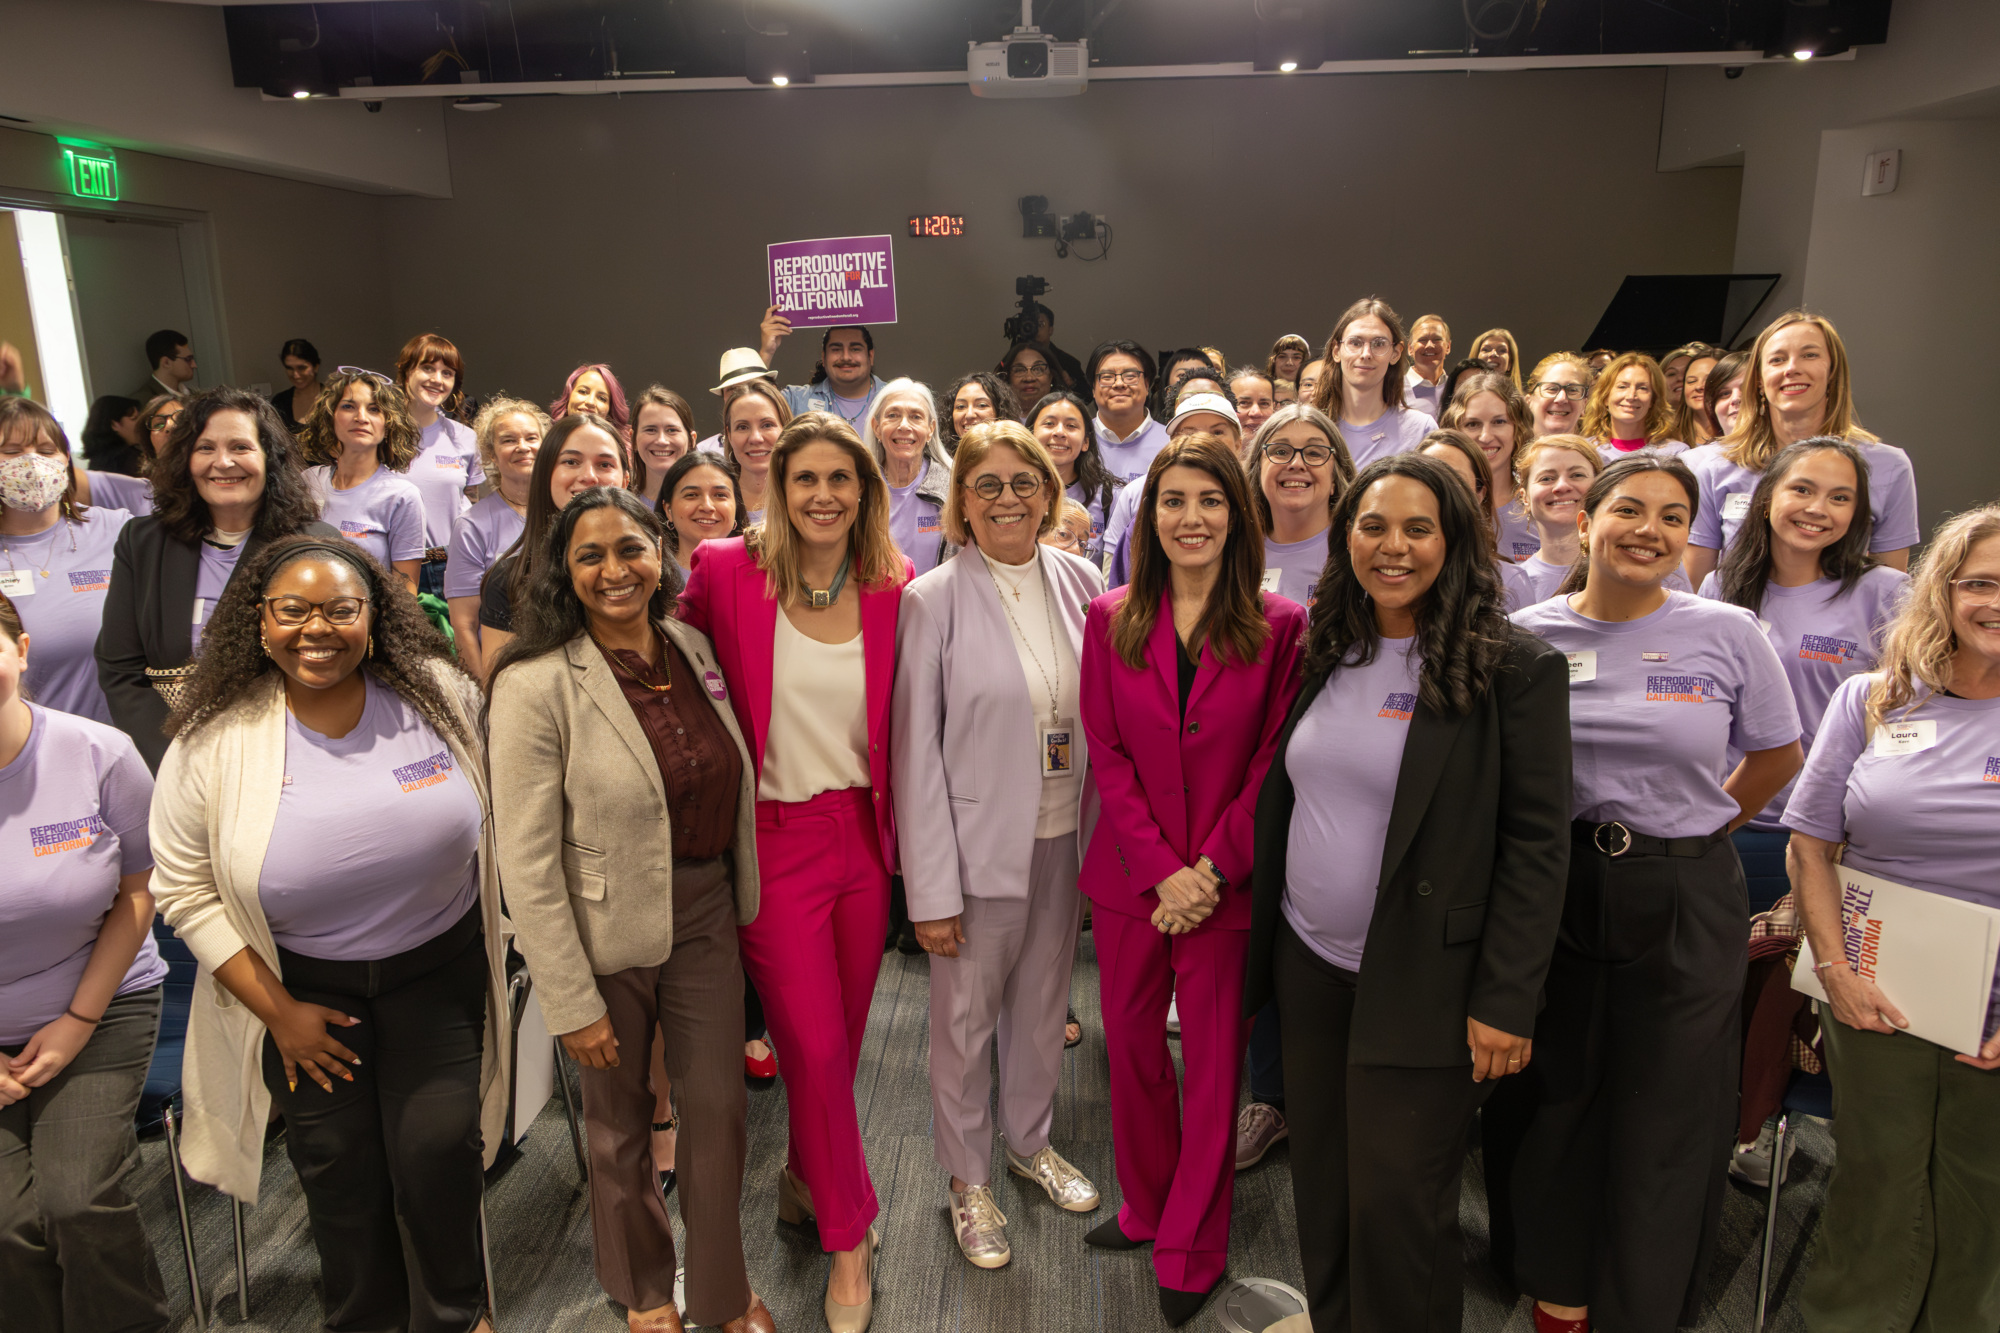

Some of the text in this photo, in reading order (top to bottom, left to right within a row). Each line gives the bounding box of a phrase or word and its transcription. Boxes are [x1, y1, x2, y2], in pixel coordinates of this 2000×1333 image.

[79, 158, 110, 197] EXIT
[916, 216, 950, 236] 11:20
[774, 251, 887, 277] REPRODUCTIVE
[775, 270, 888, 294] FREEDOM FOR ALL
[776, 289, 864, 312] CALIFORNIA
[72, 583, 110, 593] CALIFORN
[1800, 642, 1839, 655] FREEDOM
[1803, 634, 1858, 651] REPRODUCTIVE
[1799, 649, 1843, 664] CALIFORNIA
[1646, 684, 1693, 694] FREEDOM
[1701, 686, 1716, 697] ALL
[1647, 675, 1715, 690] REPRODUCTIVE
[1382, 701, 1415, 713] FREEDO
[1646, 692, 1704, 704] CALIFORNIA
[392, 751, 449, 778] REPRODUCTIVE
[396, 766, 437, 785] FREEDOM
[439, 759, 452, 771] ALL
[401, 772, 449, 793] CALIFORNIA
[30, 813, 102, 838] REPRODUCTIVE
[32, 829, 81, 847] FREEDOM
[89, 823, 105, 836] ALL
[34, 836, 94, 857] CALIFORNIA
[1850, 911, 1860, 928] FOR
[1855, 889, 1874, 917] ALL
[1859, 918, 1883, 984] IFORNIA
